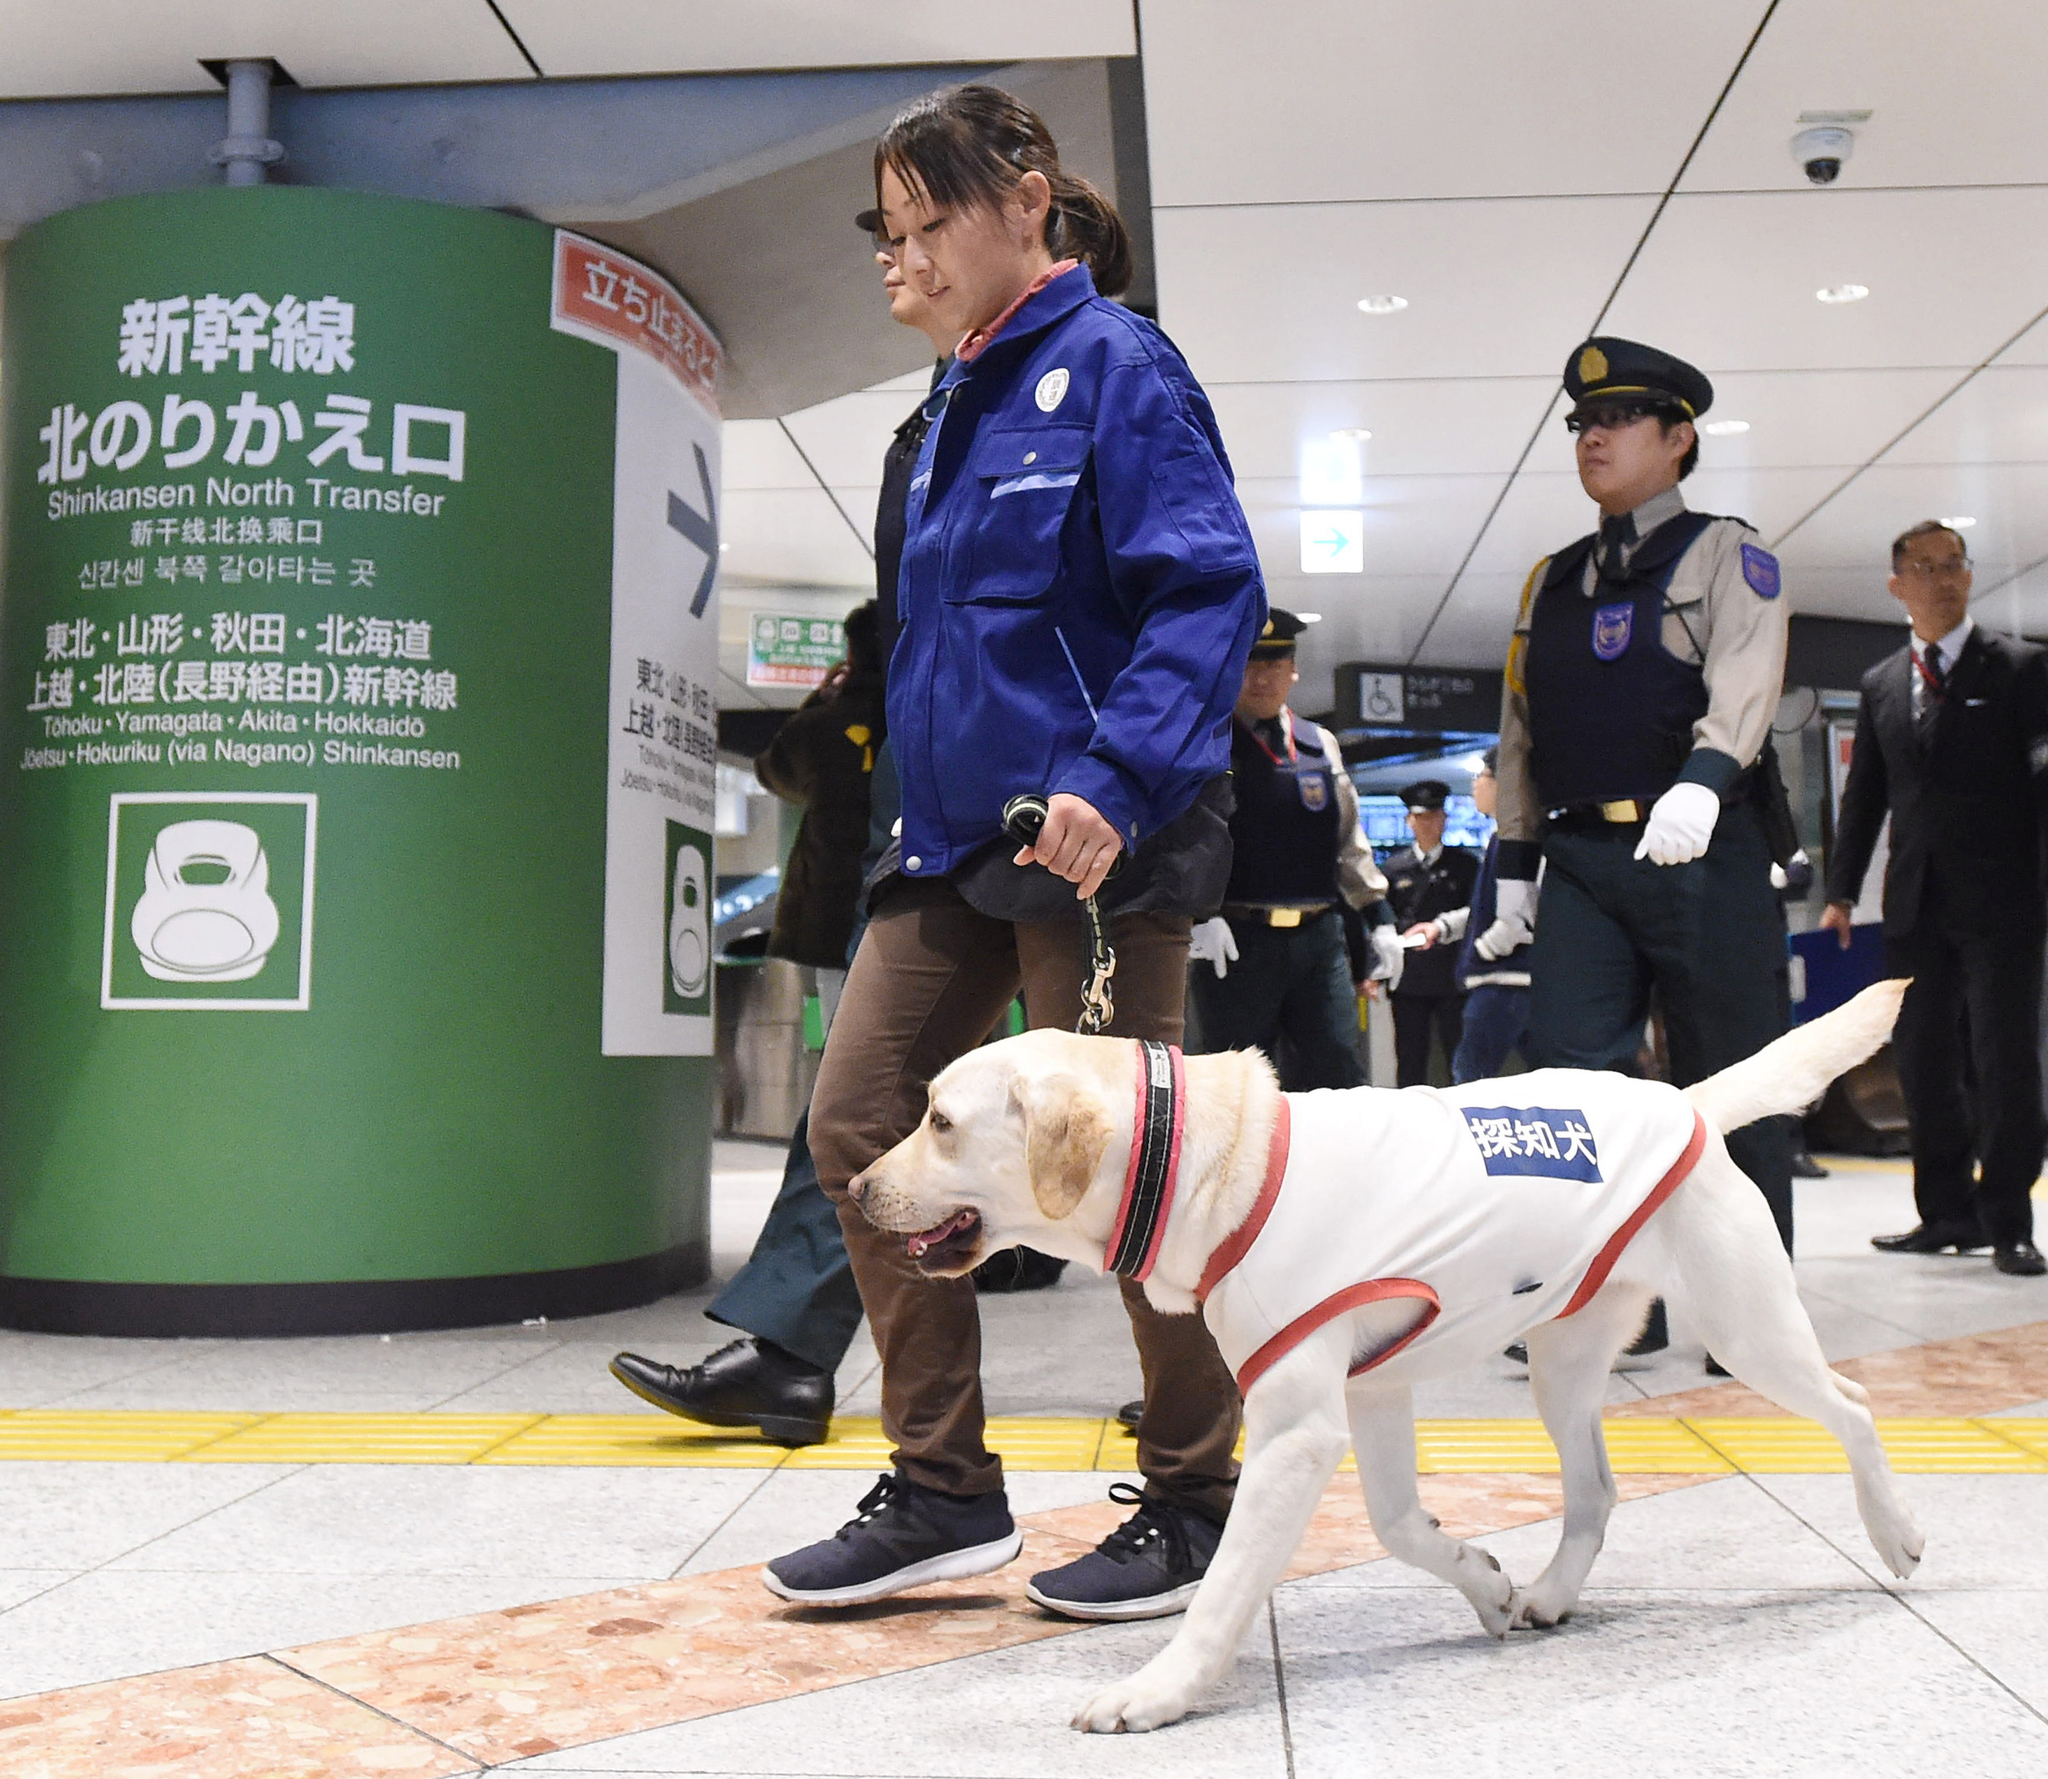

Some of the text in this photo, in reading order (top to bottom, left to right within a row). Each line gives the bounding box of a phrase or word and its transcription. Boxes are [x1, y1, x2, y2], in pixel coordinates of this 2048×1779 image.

[117, 292, 356, 378] 新幹線
[37, 390, 468, 484] 北のりかえ口
[47, 476, 446, 521] Shinkansen North Transfer
[130, 516, 324, 547] 新干线北换乘口
[78, 553, 377, 590] 신칸센 북쪽 갈아타는 곳
[167, 736, 208, 766] (via
[214, 738, 316, 768] Nagano)
[322, 739, 461, 769] Shinkansen
[1470, 1117, 1597, 1165] 探知犬
